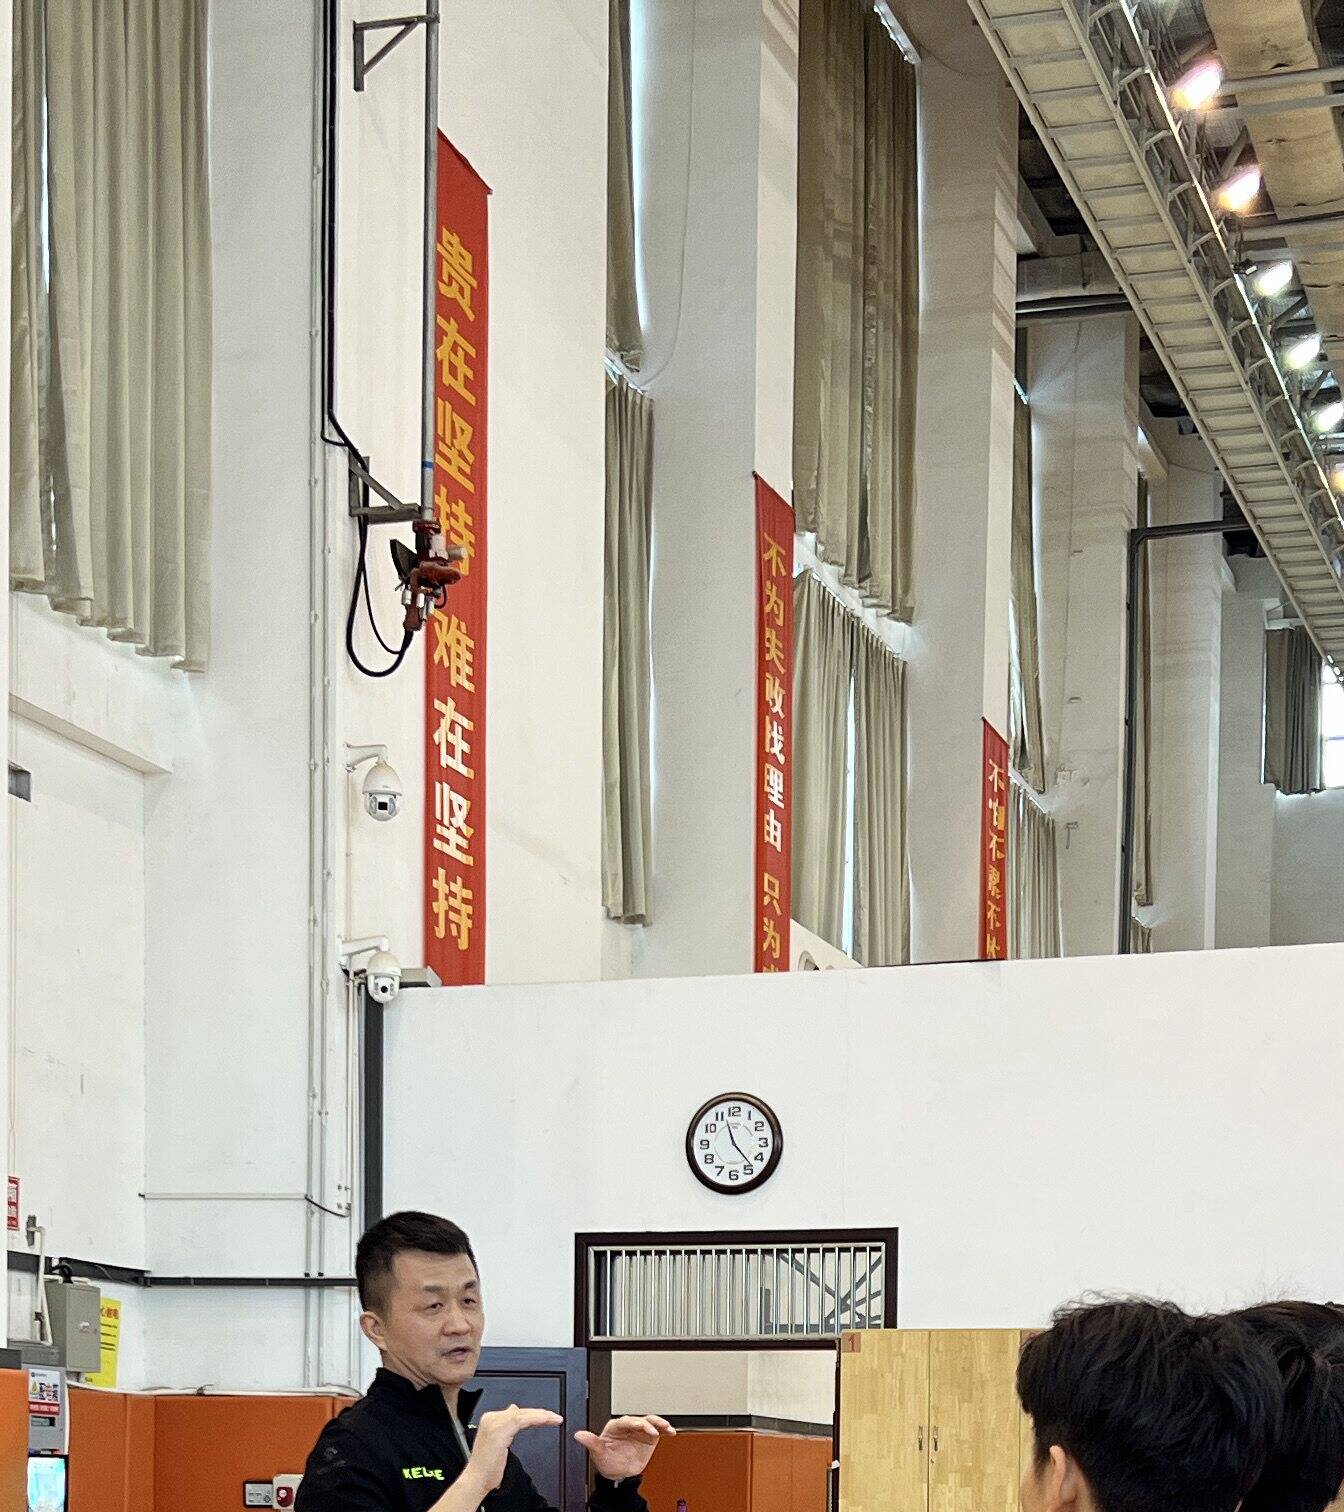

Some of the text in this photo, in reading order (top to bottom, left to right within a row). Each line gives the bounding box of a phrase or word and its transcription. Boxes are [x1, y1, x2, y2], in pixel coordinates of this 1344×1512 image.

[430, 226, 478, 951] 贵在坚持 难在坚持
[715, 1111, 725, 1122] 11
[728, 1106, 742, 1117] 12
[747, 1110, 752, 1121] 1
[704, 1123, 717, 1134] 10
[754, 1121, 764, 1132] 2
[699, 1139, 710, 1150] 9
[758, 1137, 769, 1148] 3
[704, 1153, 715, 1164] 8
[754, 1152, 765, 1162] 4
[715, 1165, 725, 1176] 7
[728, 1169, 739, 1181] 6
[743, 1164, 754, 1175] 5
